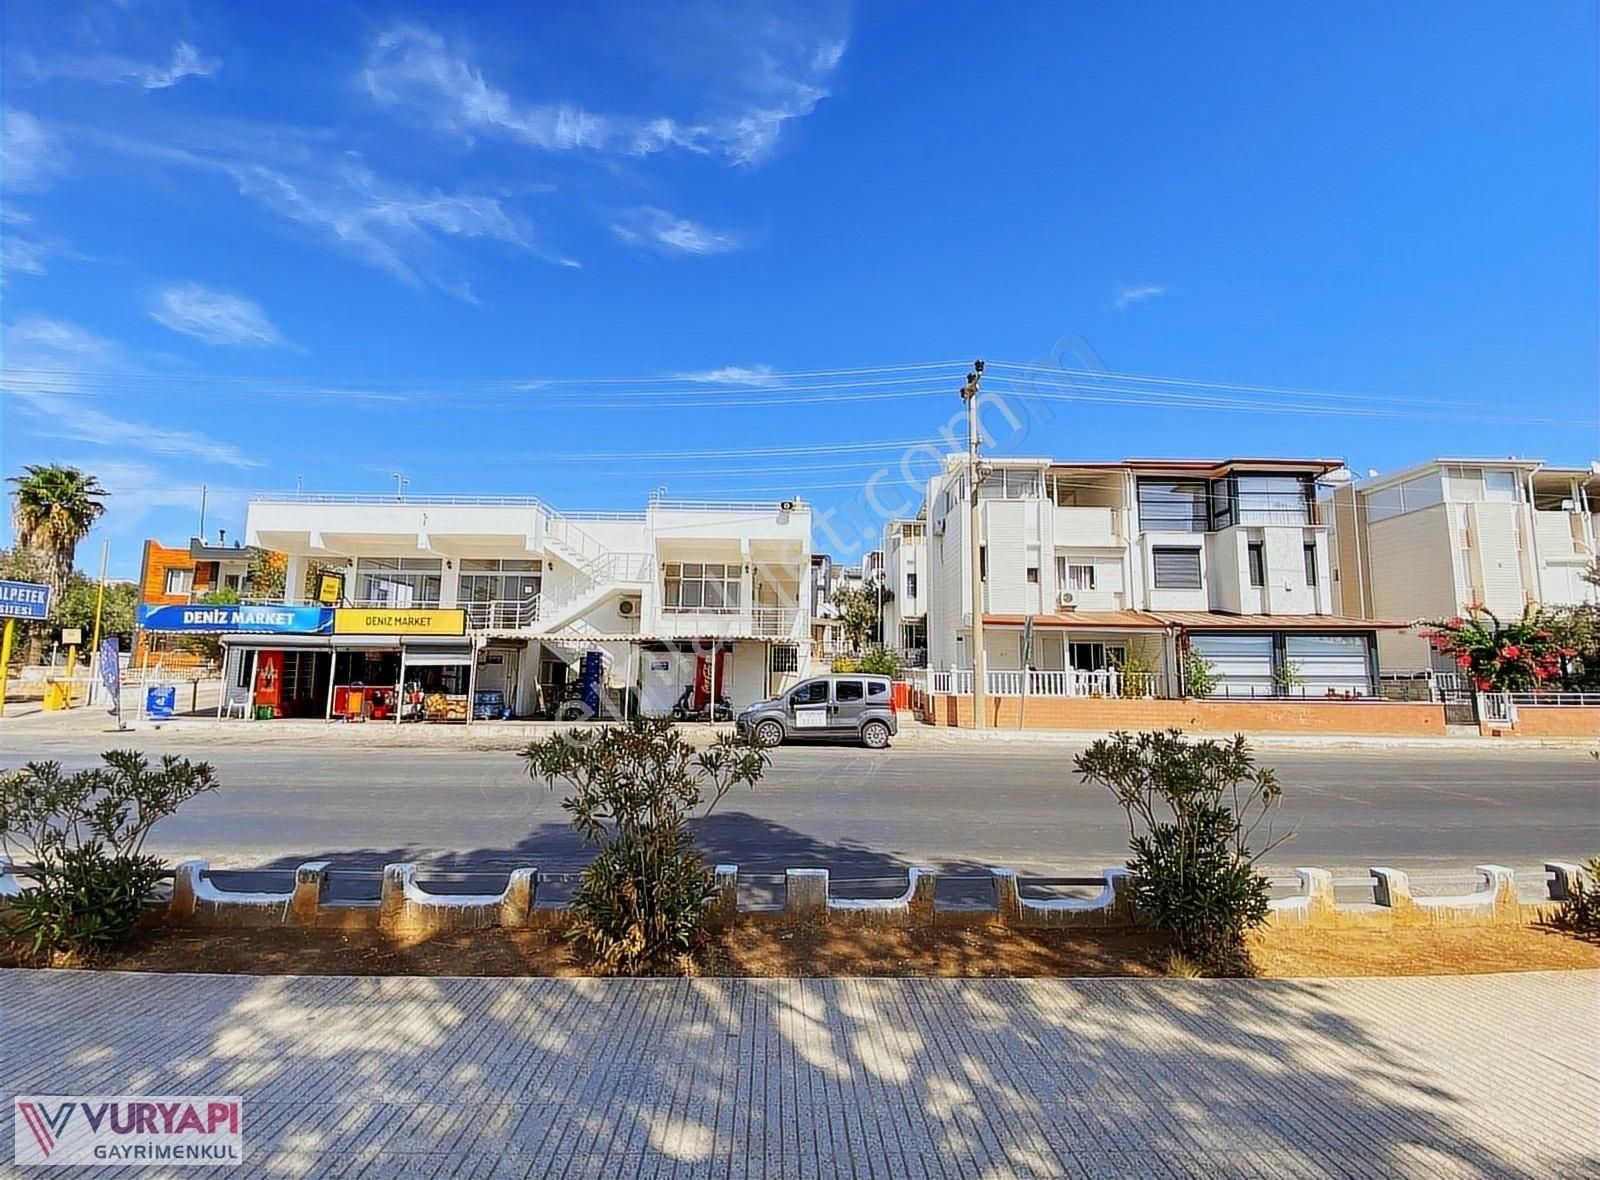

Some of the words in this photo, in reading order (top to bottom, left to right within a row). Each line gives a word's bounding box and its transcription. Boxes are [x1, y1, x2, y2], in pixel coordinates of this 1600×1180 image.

[183, 609, 228, 625] DENİZ
[230, 611, 296, 626] MARKET
[394, 616, 433, 627] MARKET
